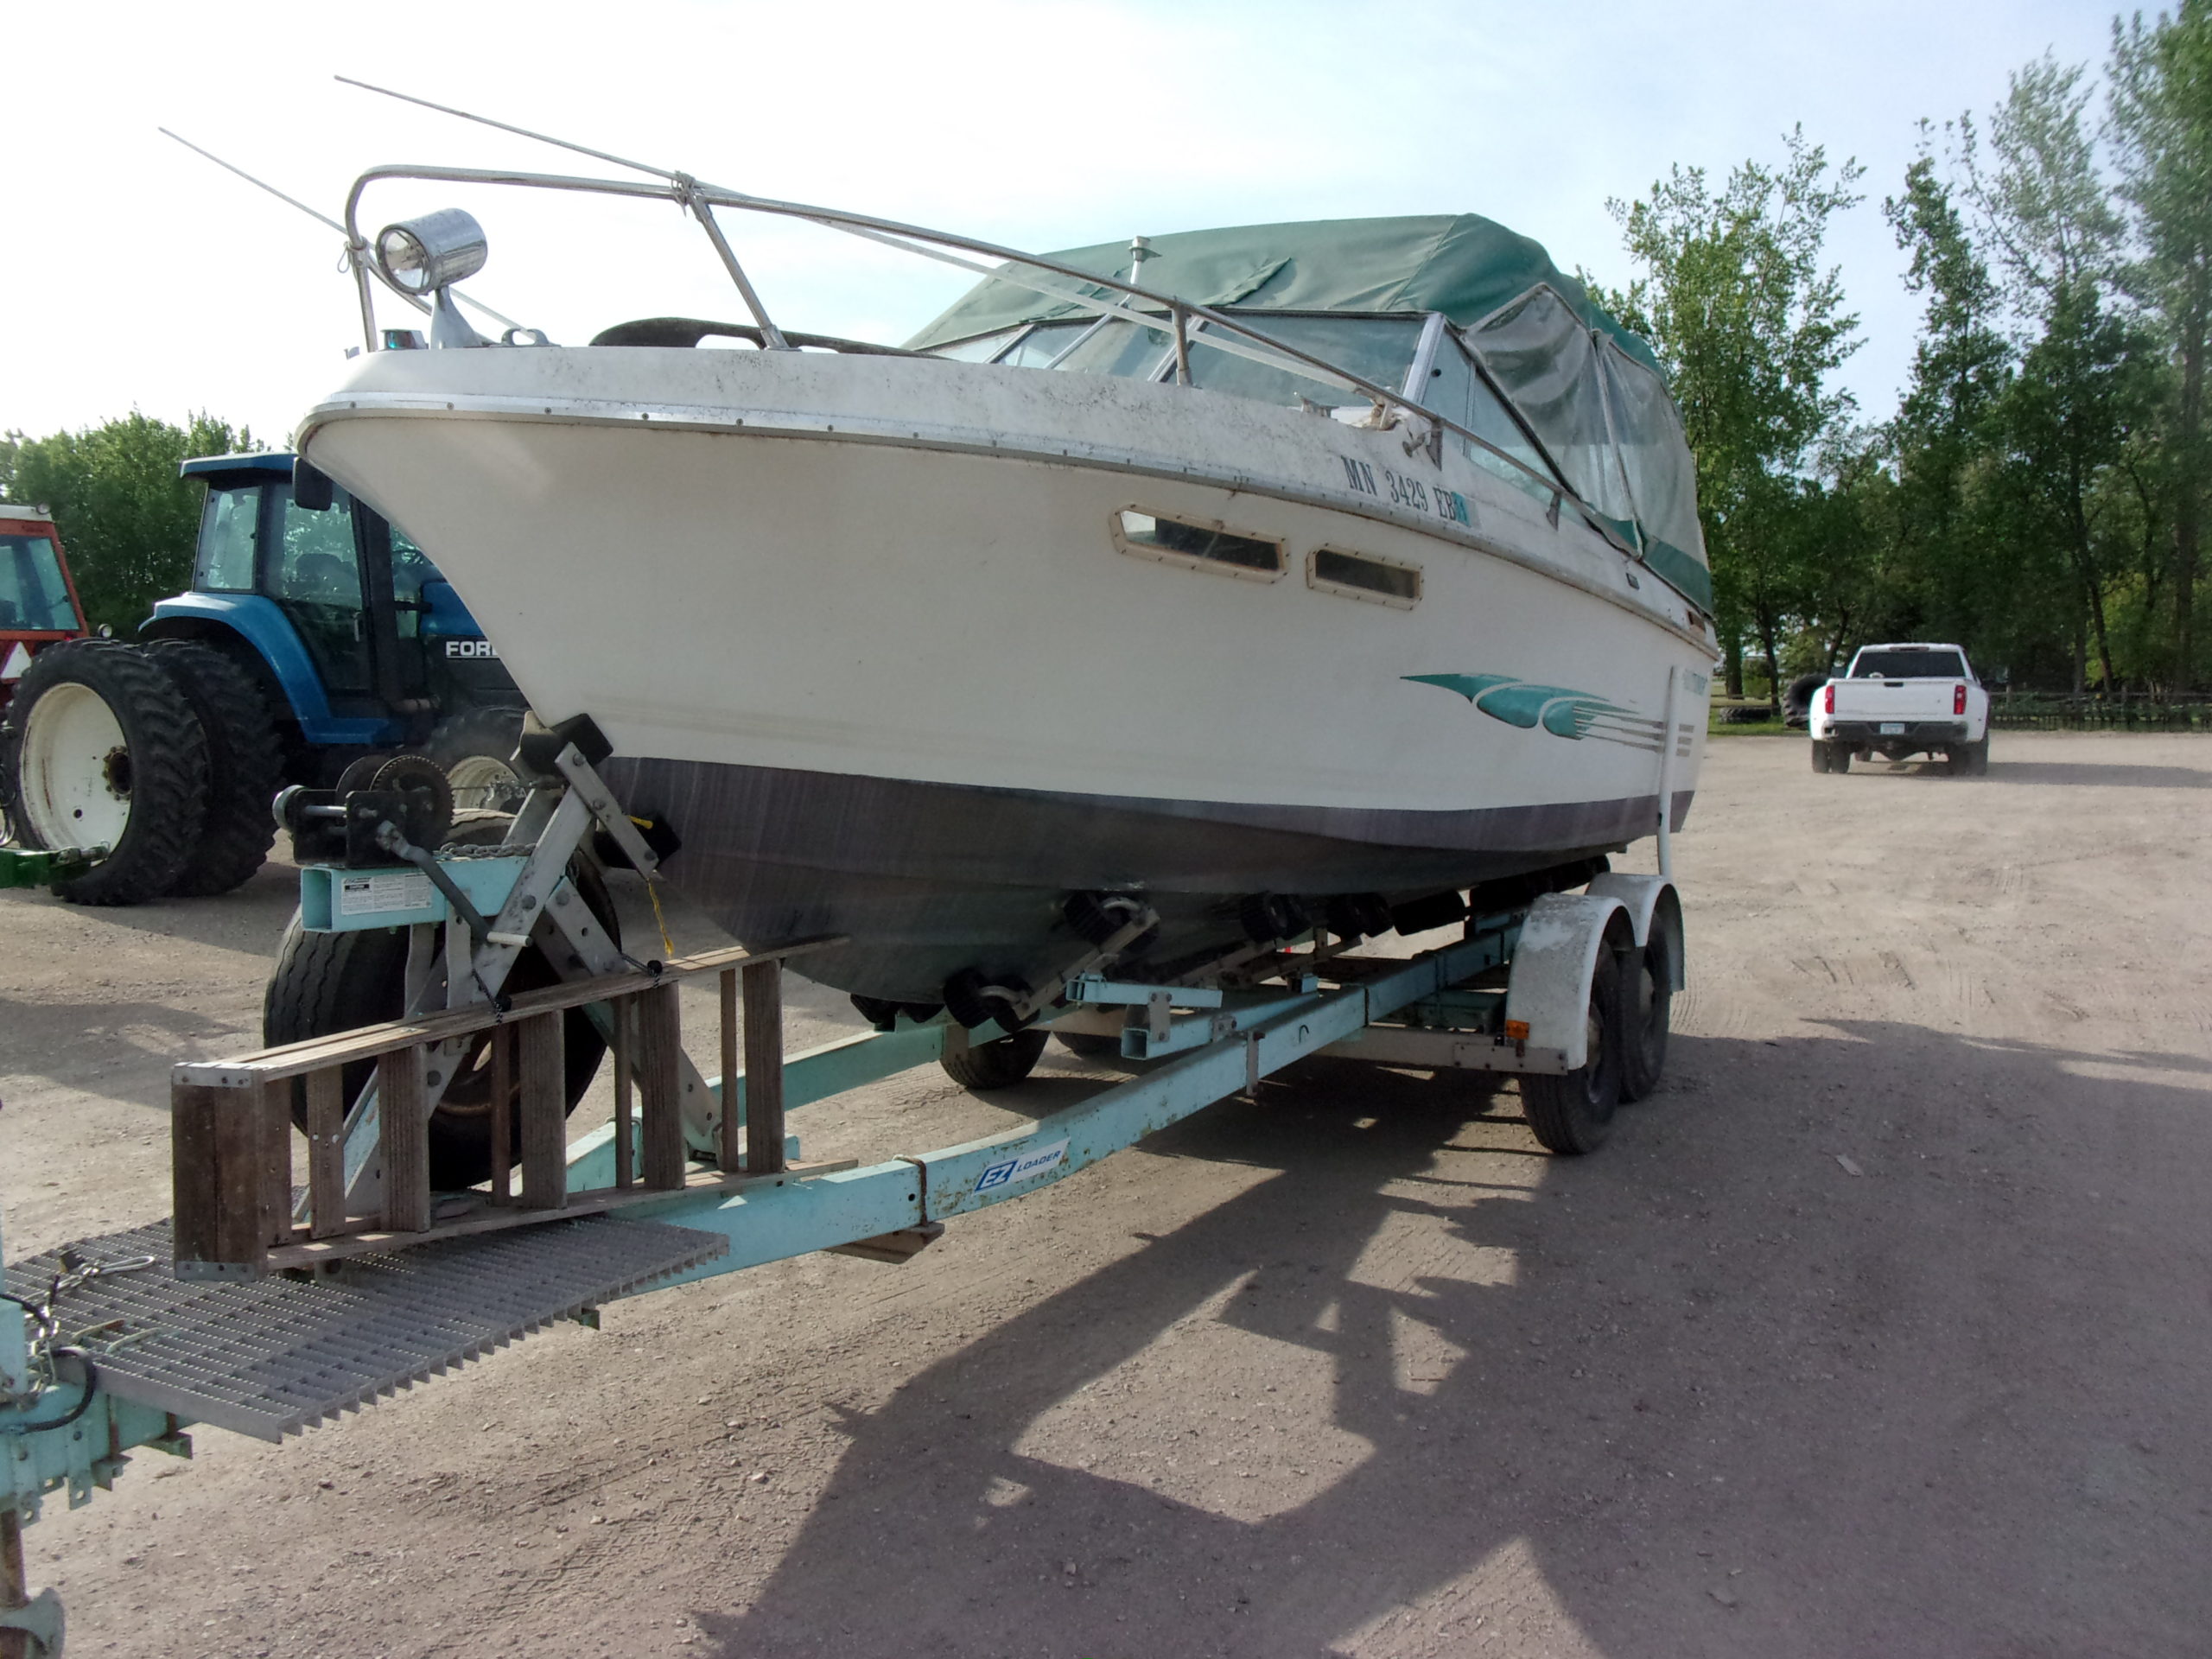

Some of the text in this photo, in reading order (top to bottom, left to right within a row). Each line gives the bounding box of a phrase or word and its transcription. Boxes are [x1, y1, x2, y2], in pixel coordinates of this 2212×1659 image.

[1341, 455, 1377, 496] MN
[1385, 470, 1428, 512] 3429
[979, 1150, 1061, 1189] EZ LOADER
